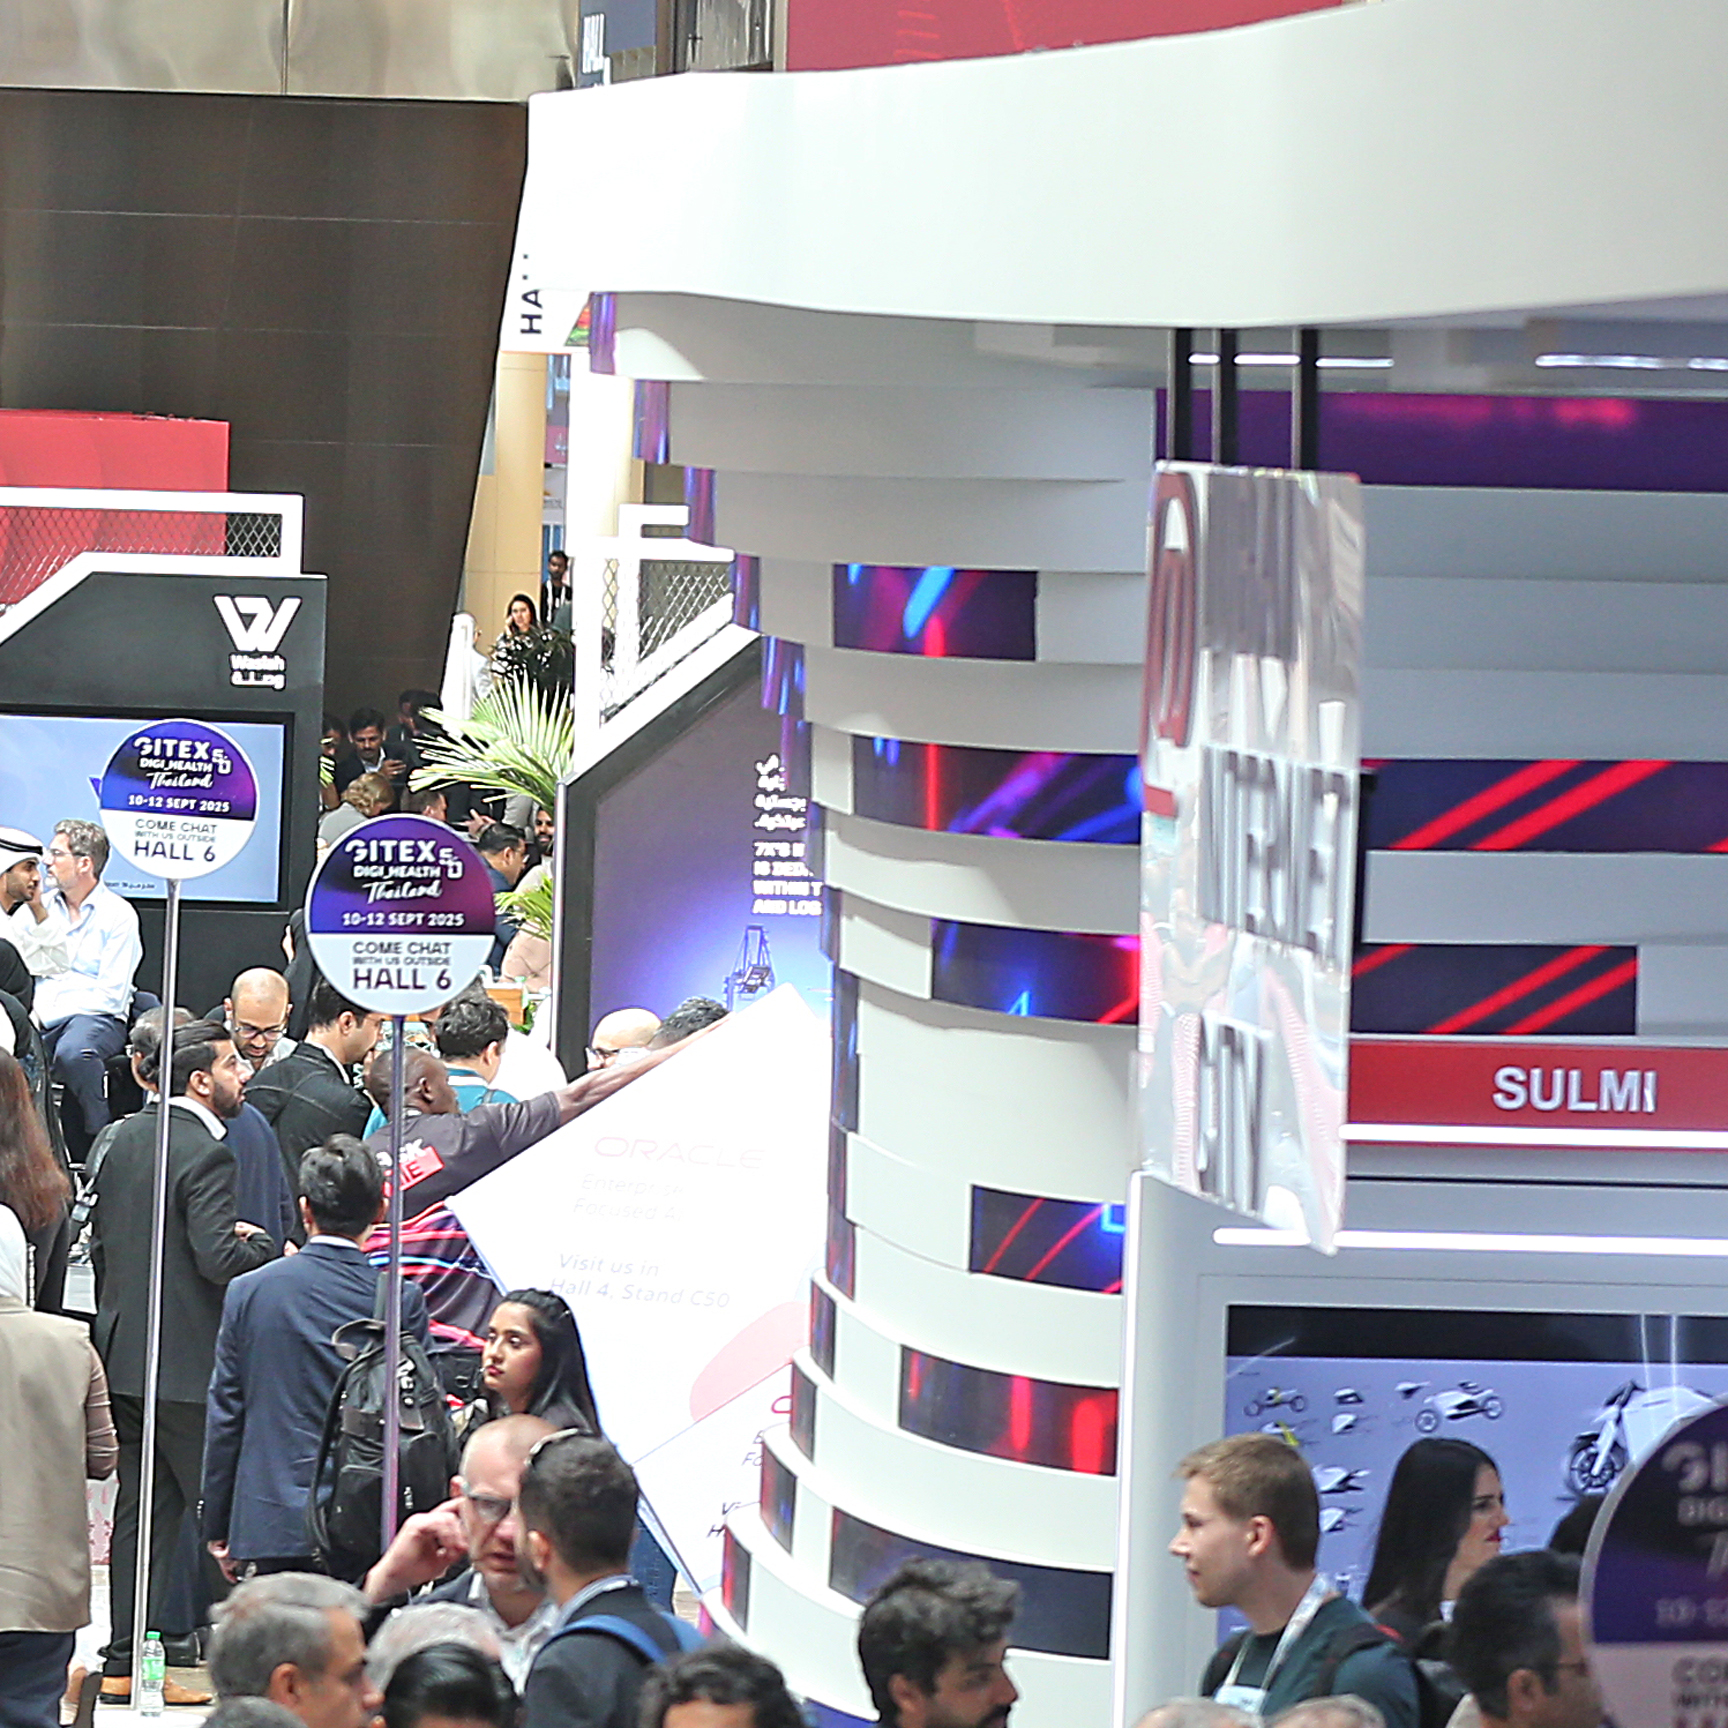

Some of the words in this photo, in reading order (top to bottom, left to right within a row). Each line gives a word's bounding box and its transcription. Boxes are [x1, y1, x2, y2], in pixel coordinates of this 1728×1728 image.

[133, 736, 211, 760] GITEX
[146, 771, 215, 790] Thailand
[128, 795, 163, 807] 10-12
[166, 797, 197, 810] SEPT
[199, 800, 230, 813] 2025
[135, 819, 176, 832] COME
[180, 822, 218, 834] CHAT
[134, 840, 194, 861] HALL
[203, 845, 216, 862] 6
[345, 839, 438, 862] GITEX
[362, 879, 443, 904] Thailand
[342, 912, 385, 926] 10-12
[388, 912, 424, 926] SEPT
[427, 913, 465, 927] 2025
[352, 942, 403, 954] COME
[407, 942, 452, 954] CHAT
[353, 957, 382, 966] WITH
[385, 957, 400, 966] US
[403, 957, 452, 966] OUTSIDE
[353, 967, 427, 990] HALL
[436, 968, 452, 990] 6
[1492, 1064, 1658, 1114] SULMI
[594, 1136, 765, 1169] ORACLE
[559, 1253, 603, 1272] Visit
[611, 1261, 634, 1274] us
[640, 1260, 659, 1277] in
[550, 1278, 591, 1296] Hall
[622, 1284, 683, 1304] Stand
[690, 1290, 731, 1308] C50
